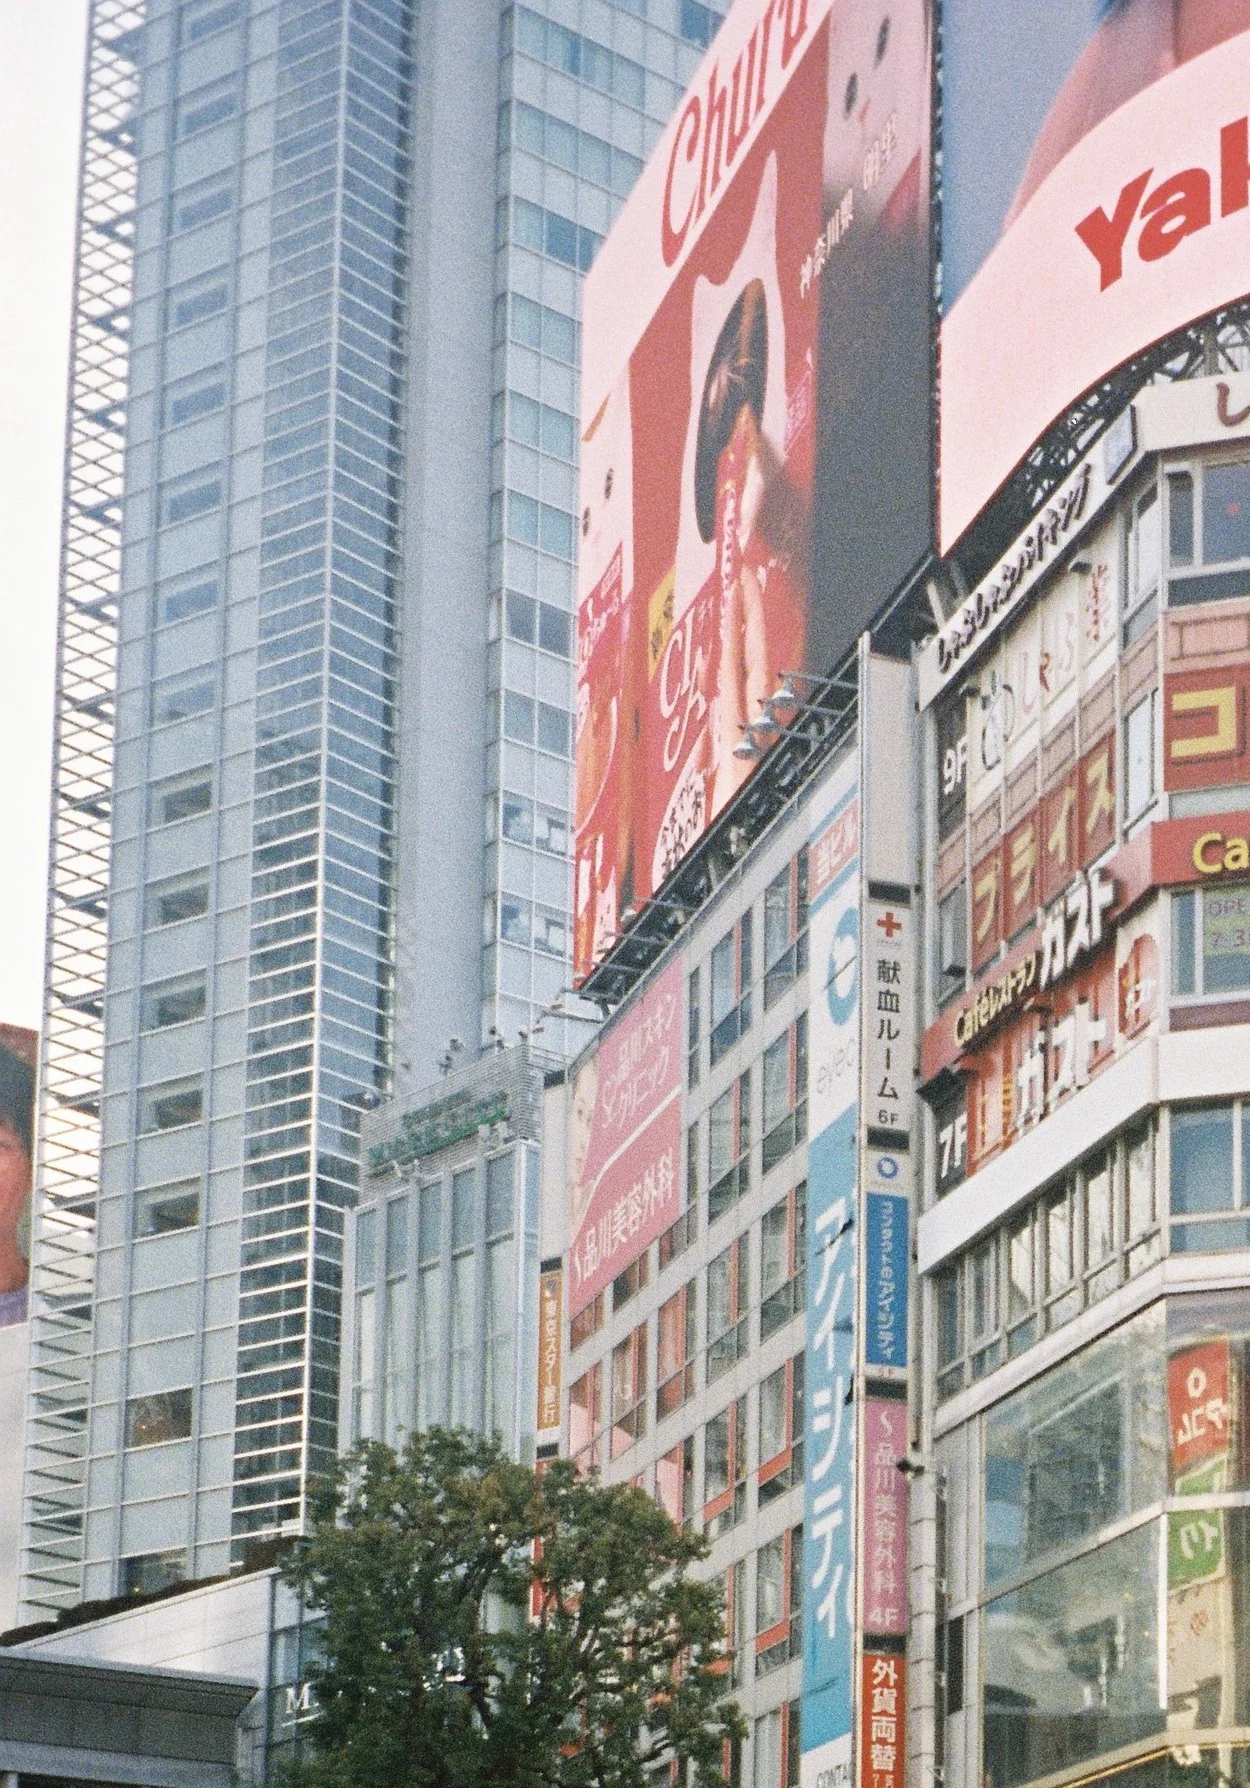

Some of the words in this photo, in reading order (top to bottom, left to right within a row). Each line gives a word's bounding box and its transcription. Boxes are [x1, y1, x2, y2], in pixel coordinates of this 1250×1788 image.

[1039, 868, 1115, 990] ガスト
[877, 959, 901, 1100] 献血ルーム
[1016, 999, 1107, 1137] ガスト
[878, 1109, 898, 1126] 6F
[583, 1147, 673, 1281] 品川美容外科
[869, 1607, 900, 1626] 4F
[871, 1658, 898, 1772] 外貨両替
